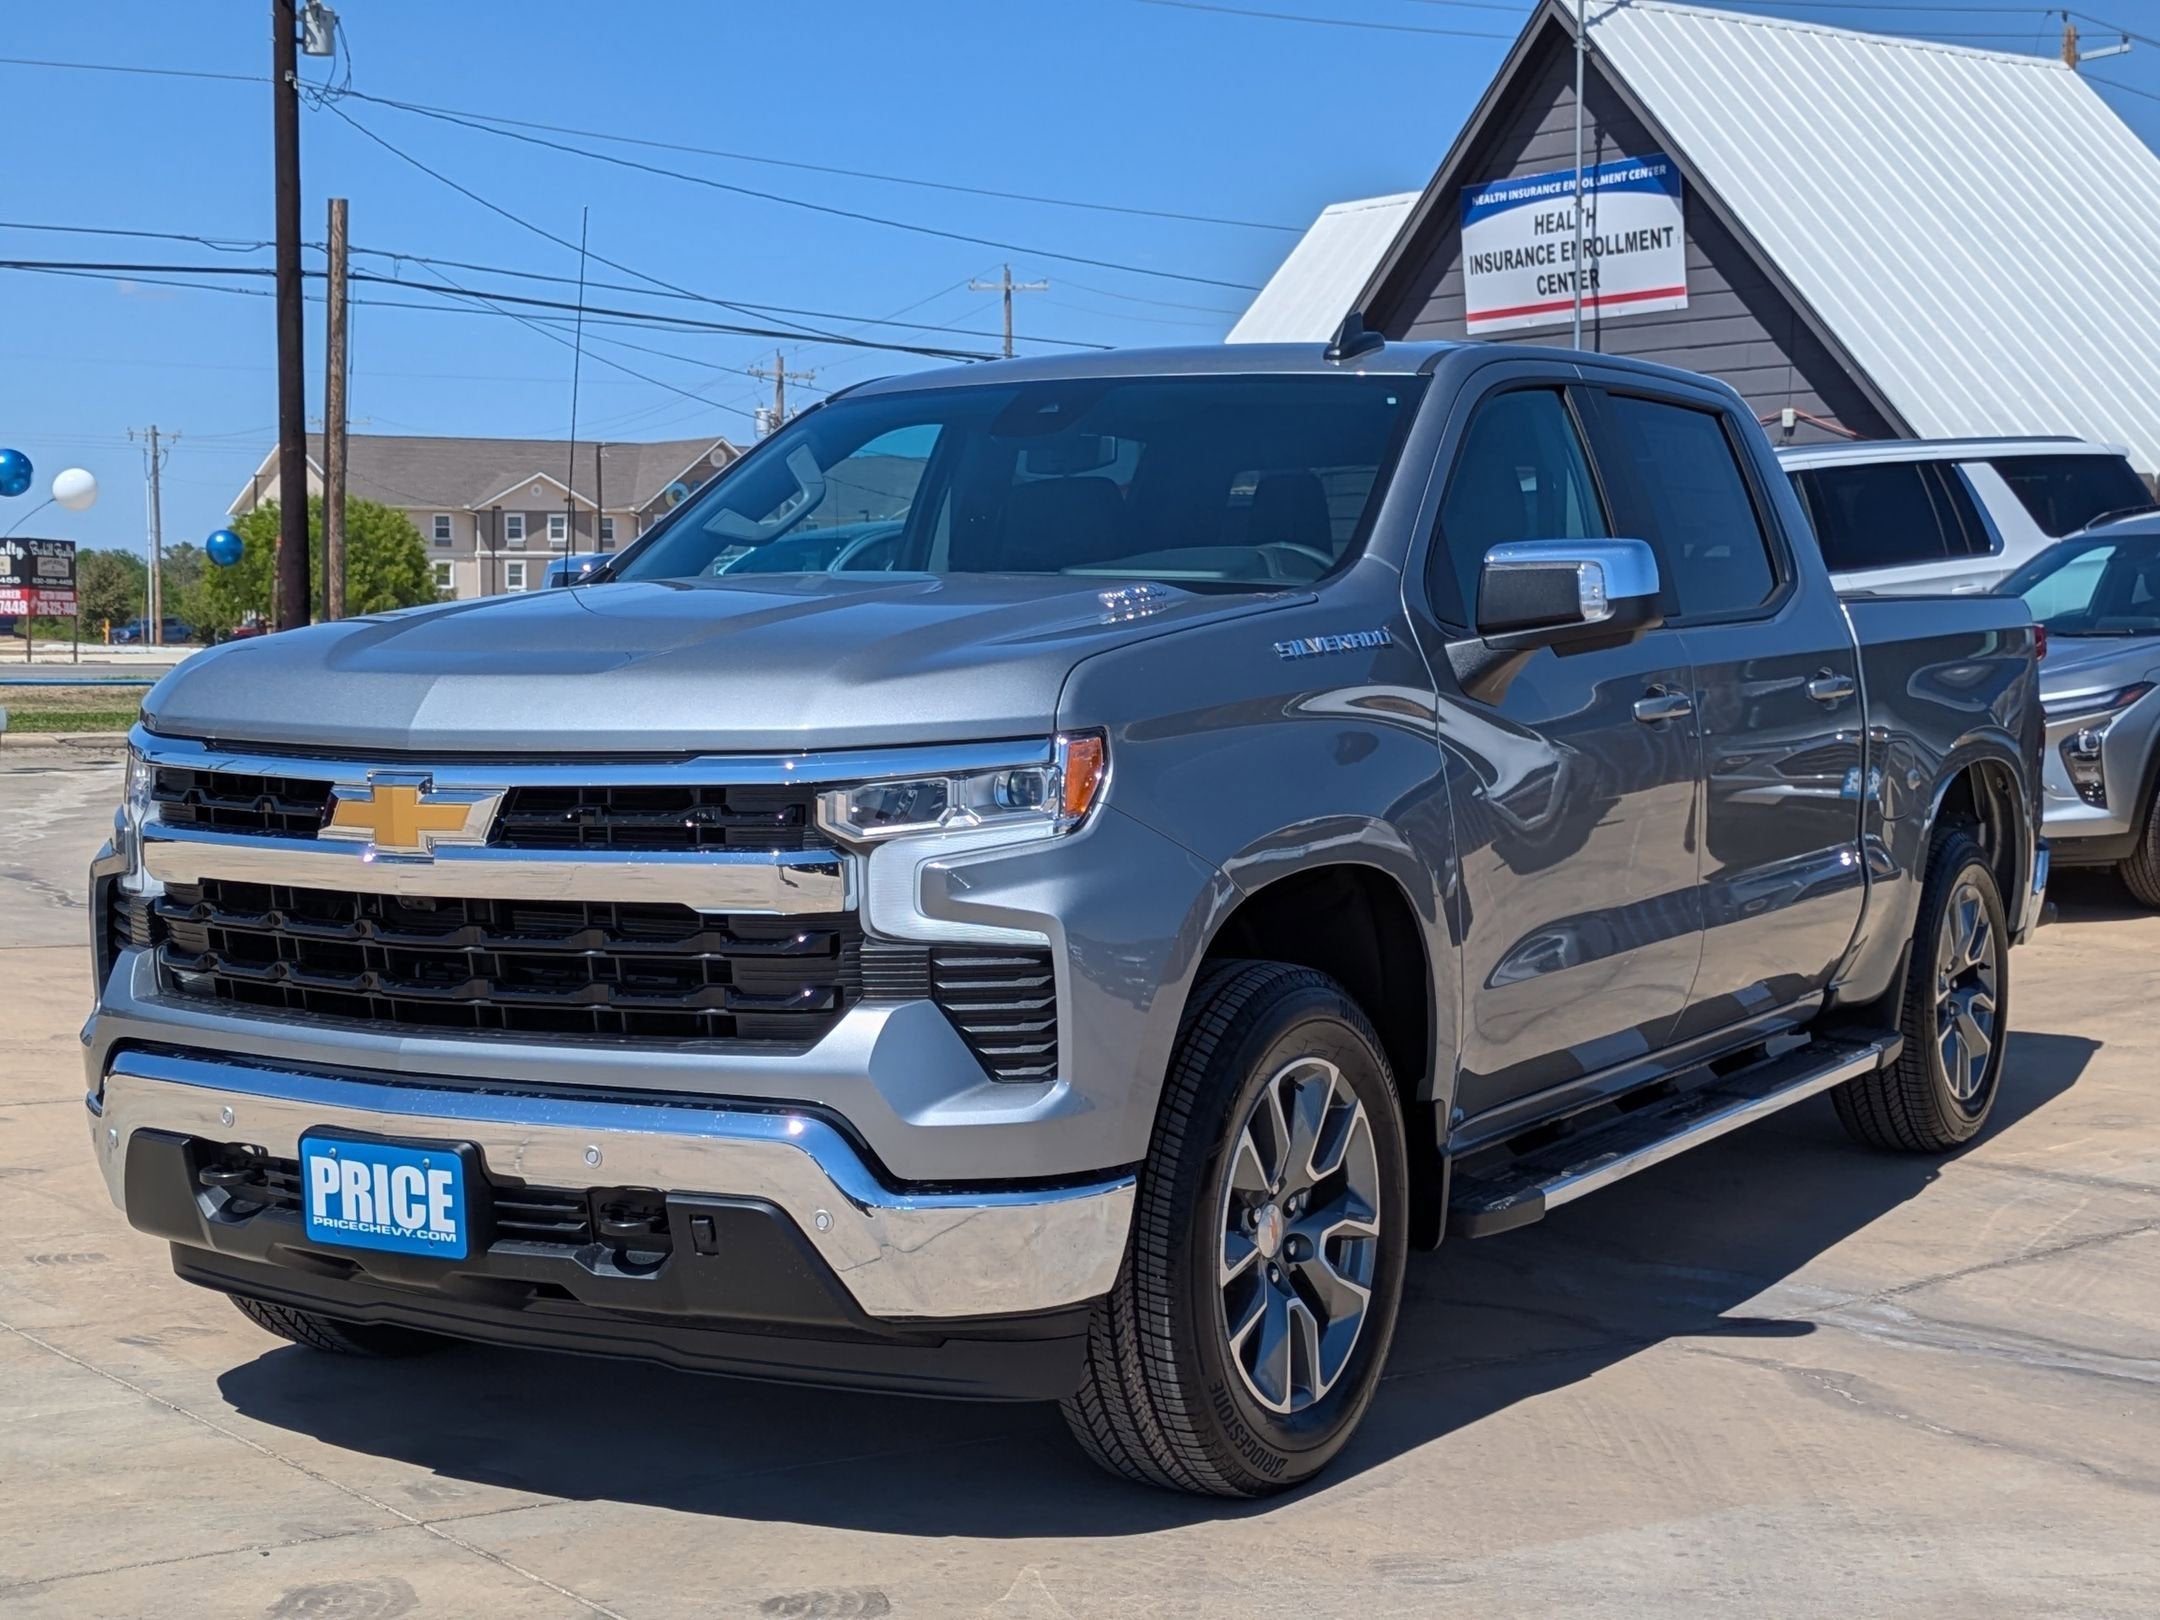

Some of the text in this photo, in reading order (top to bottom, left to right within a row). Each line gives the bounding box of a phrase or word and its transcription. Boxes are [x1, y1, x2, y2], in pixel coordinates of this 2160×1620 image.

[1472, 165, 1667, 206] HEALTH INSURANCE ENOLLMENT CENTER
[1534, 207, 1597, 236] HEALH
[1470, 244, 1556, 275] INSURANCE
[1537, 268, 1600, 296] CENTER
[1273, 628, 1393, 658] SILVERADO
[309, 1155, 457, 1233] PRICE
[313, 1215, 457, 1243] PRICECHEVY.COM
[1208, 1378, 1289, 1479] BRIDGESTONE
